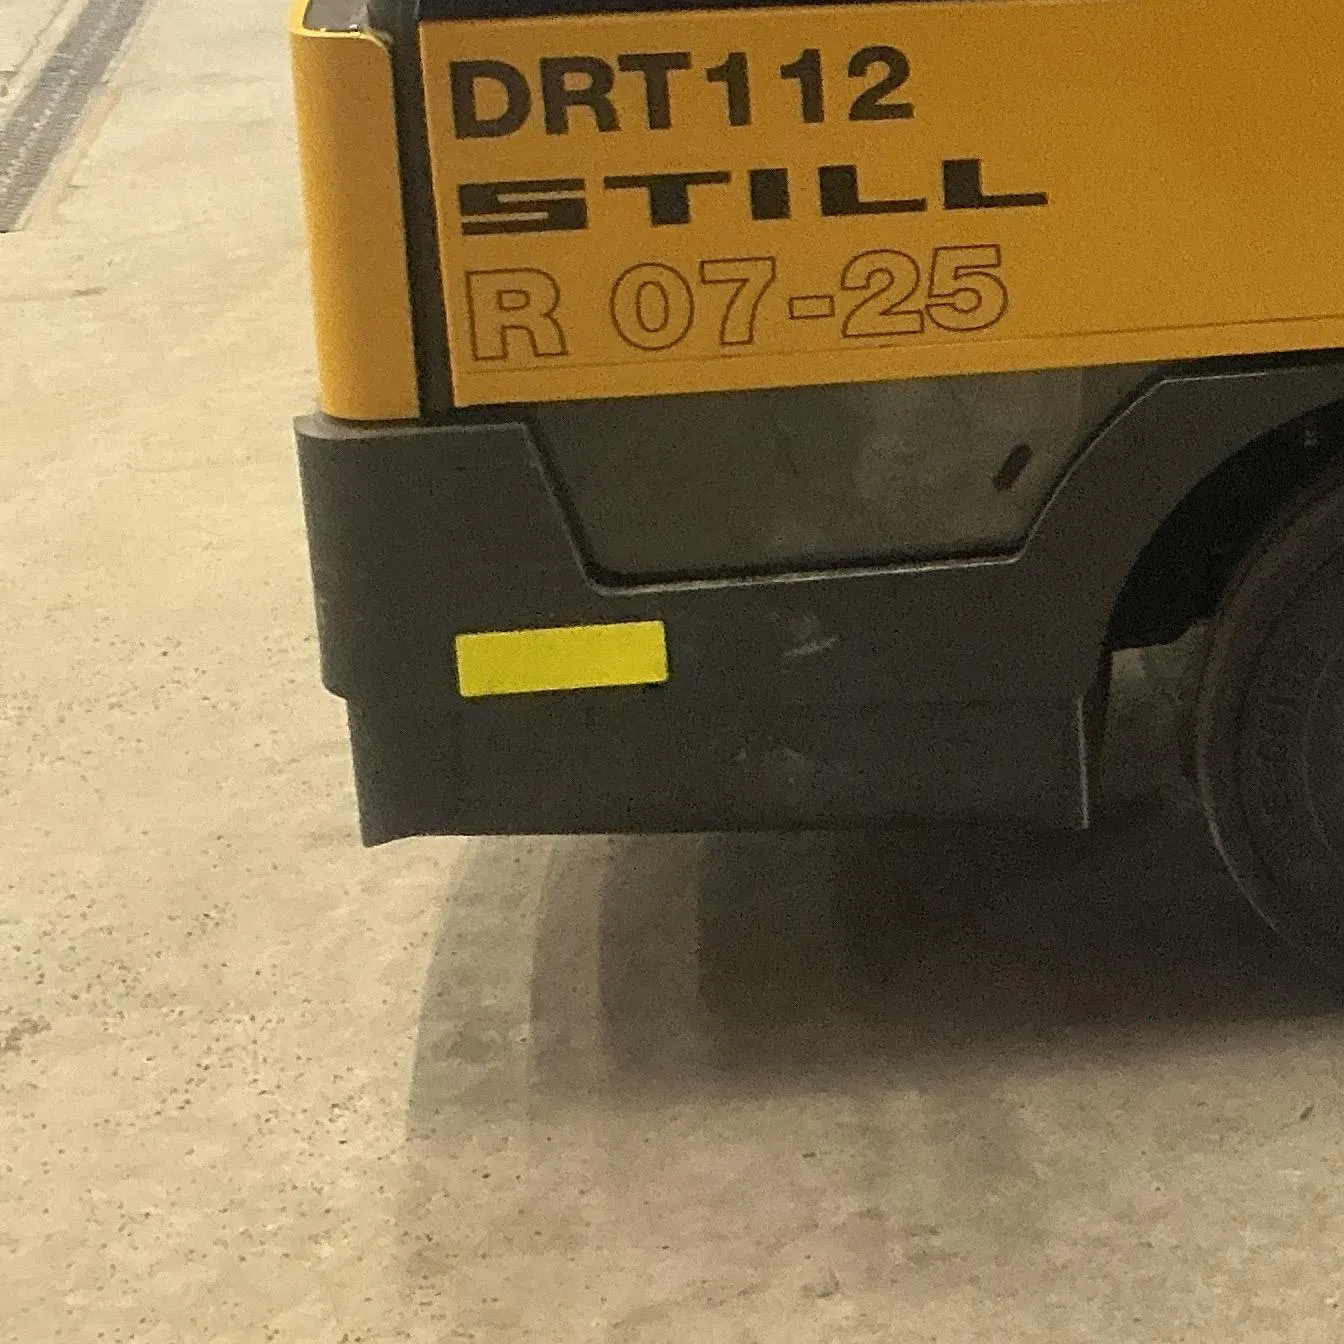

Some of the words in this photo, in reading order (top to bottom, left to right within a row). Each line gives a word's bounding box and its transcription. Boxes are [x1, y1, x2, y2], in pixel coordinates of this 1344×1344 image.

[449, 45, 916, 140] DRT112
[457, 158, 1049, 236] STILL
[465, 266, 569, 363] R
[608, 244, 1009, 353] 07-25
